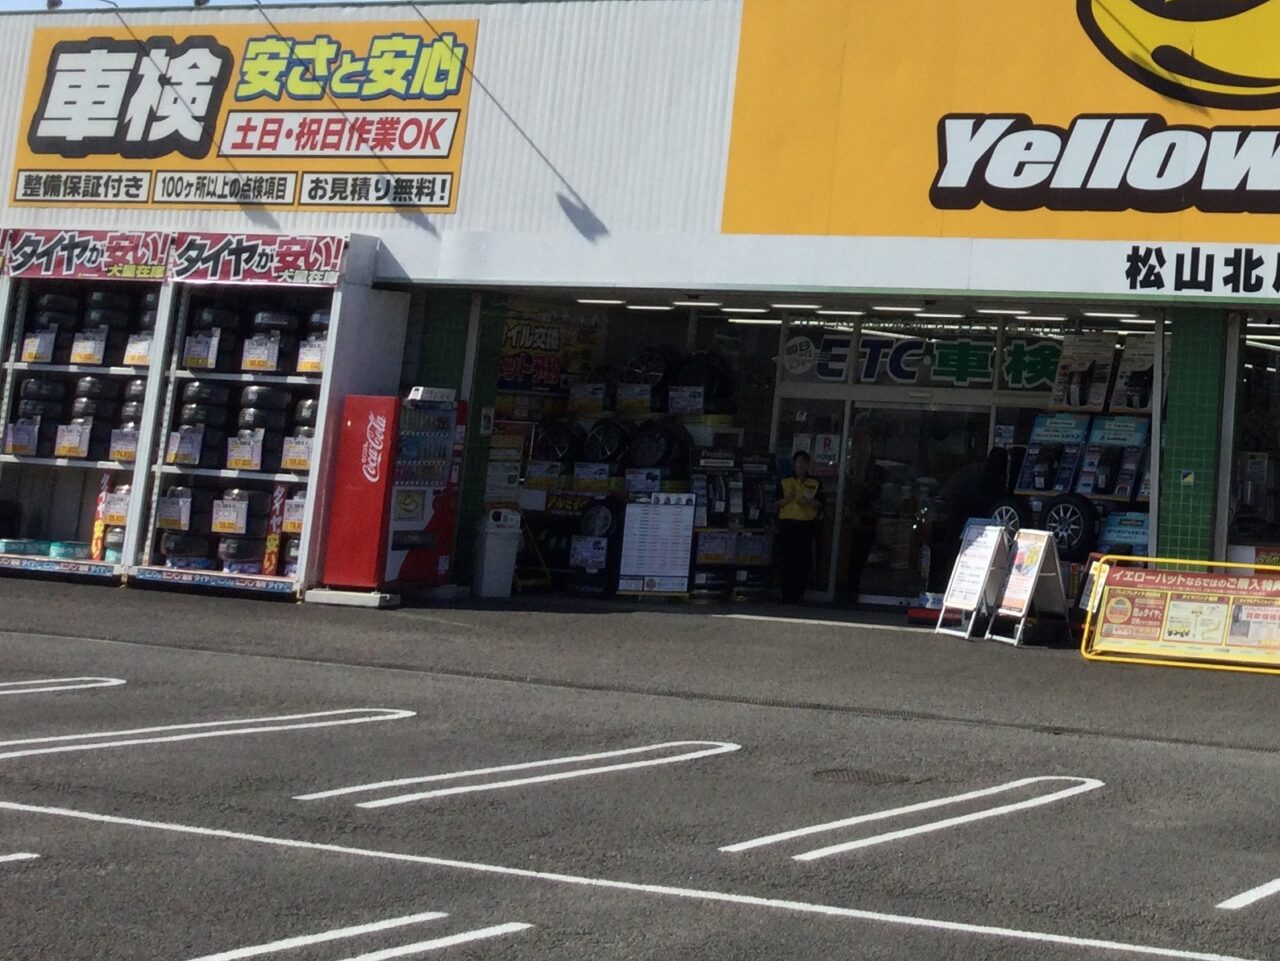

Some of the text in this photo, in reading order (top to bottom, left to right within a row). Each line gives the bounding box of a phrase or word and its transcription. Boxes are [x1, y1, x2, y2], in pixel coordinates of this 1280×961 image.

[237, 35, 466, 99] 安さと安心
[33, 43, 226, 147] 車検
[231, 117, 446, 152] 土日・祝日作業OK
[22, 174, 143, 199] 整備保証付き
[308, 176, 447, 201] お見積り無料!
[9, 231, 171, 276] タイヤが安い!
[174, 235, 344, 280] タイヤが安い!
[362, 411, 387, 483] Coca-Cola
